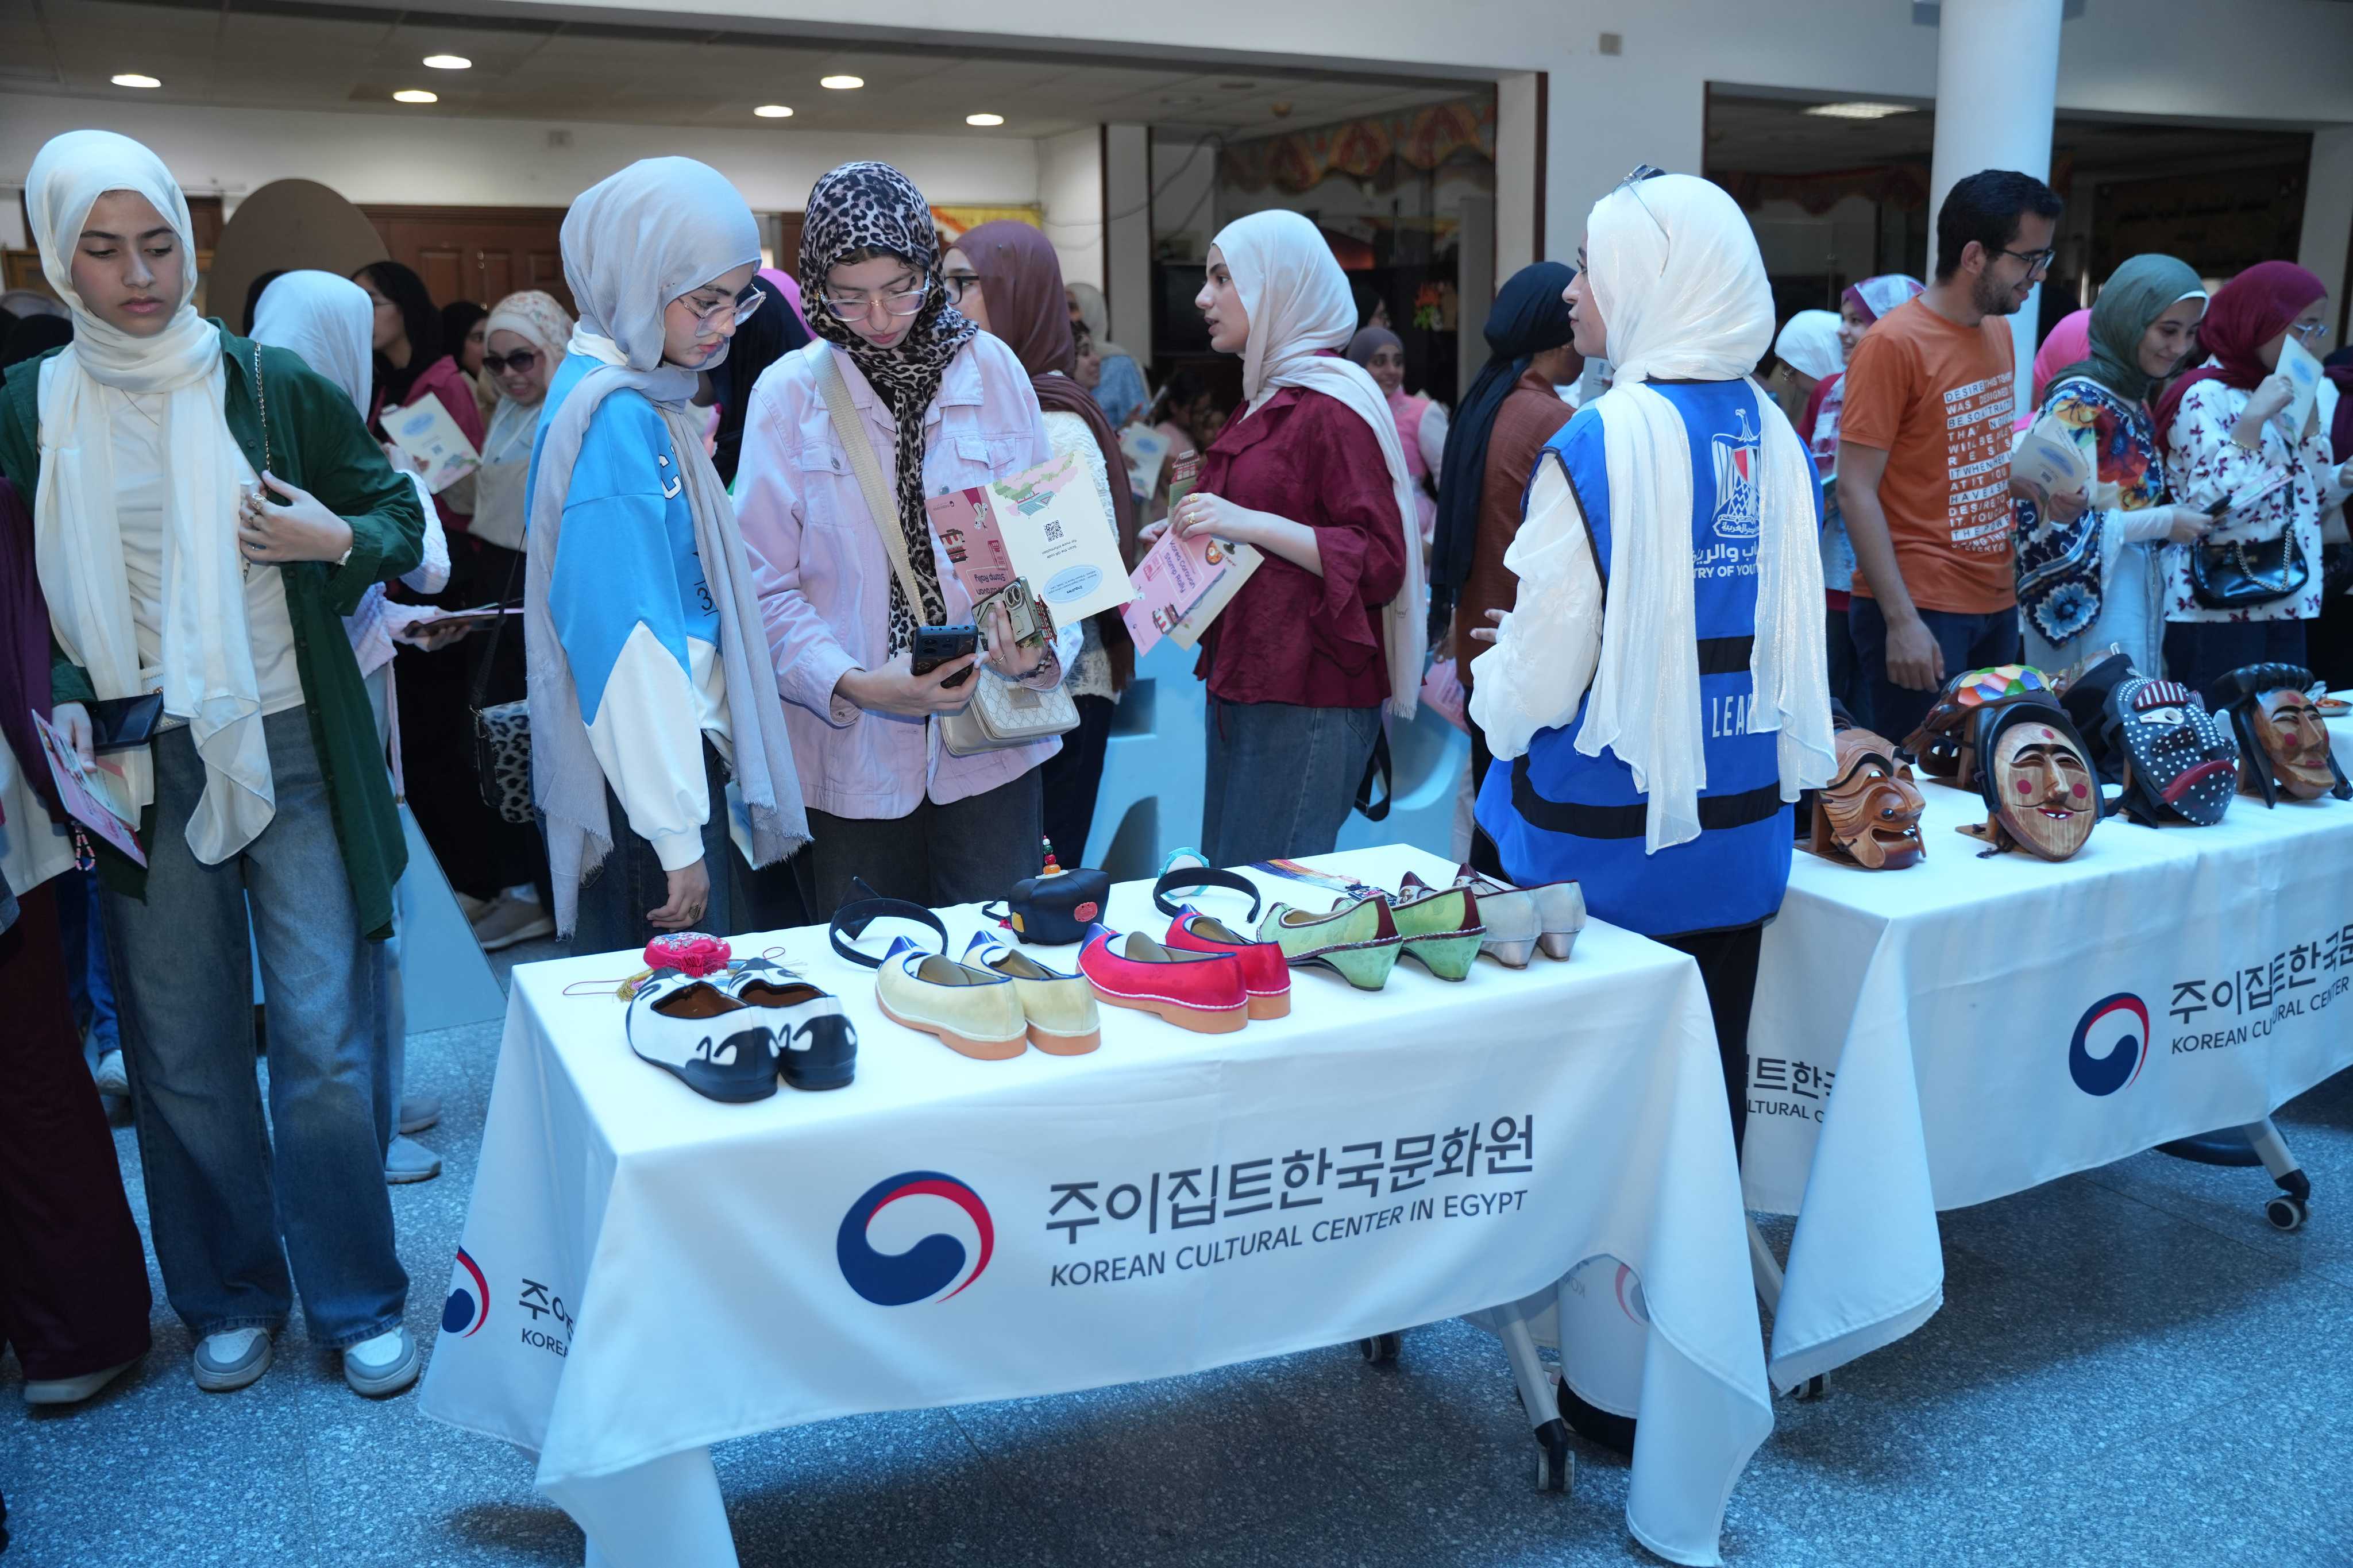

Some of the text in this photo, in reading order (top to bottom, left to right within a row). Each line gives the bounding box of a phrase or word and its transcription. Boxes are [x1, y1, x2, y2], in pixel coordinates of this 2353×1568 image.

[1946, 381, 1984, 401] DESIRE
[1946, 400, 1972, 414] WAS
[1949, 417, 1962, 427] BE
[1967, 412, 1980, 423] SO
[1947, 425, 1980, 442] THA
[1963, 462, 1992, 474] WHEN
[1951, 488, 1987, 504] HAVE
[1949, 498, 1995, 517] DESIRE
[1972, 512, 1993, 524] YOU
[1953, 527, 1979, 539] THE
[974, 574, 1005, 584] Stamp Rally
[1164, 553, 1186, 593] Stamp Rally
[1179, 561, 1195, 589] Caravan
[1717, 565, 1734, 577] OF
[2172, 1026, 2247, 1055] KOREAN
[1046, 1114, 1534, 1245] 주이집트한국문화원
[1051, 1188, 1529, 1287] KOREAN CULTURAL CENTER IN EGYPT
